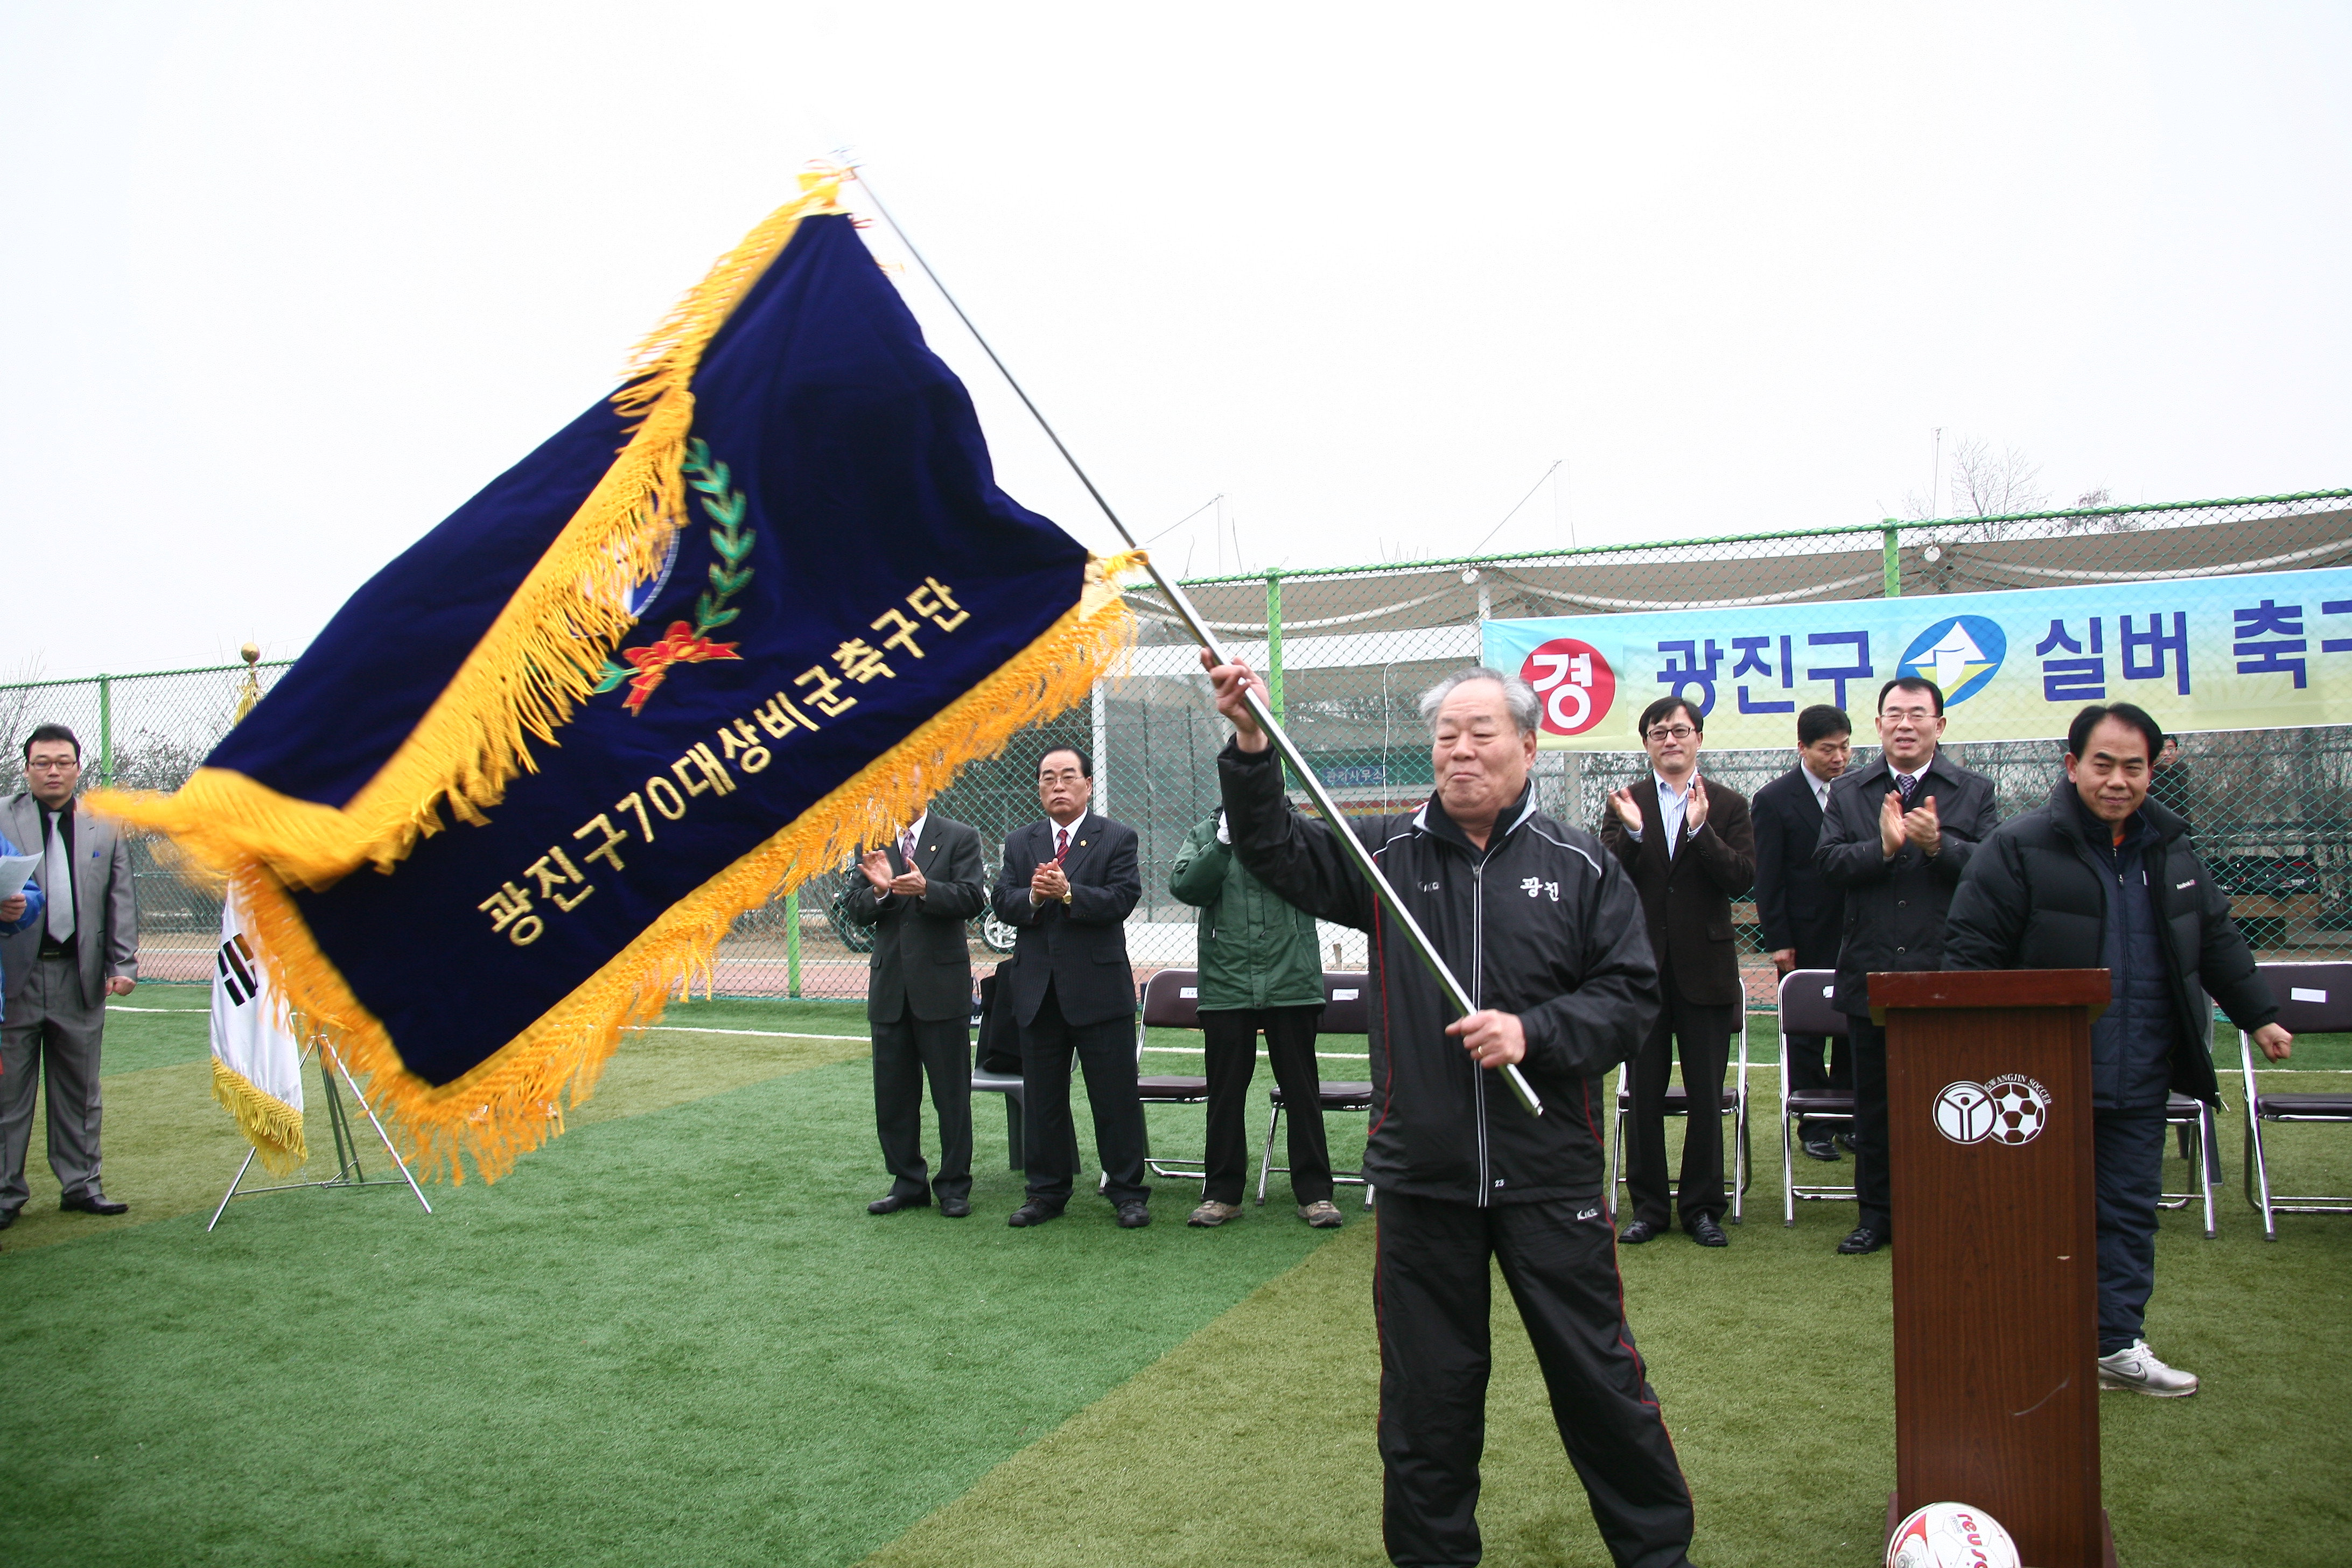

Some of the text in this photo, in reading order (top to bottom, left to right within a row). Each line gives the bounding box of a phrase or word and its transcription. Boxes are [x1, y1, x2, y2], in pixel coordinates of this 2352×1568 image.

[1532, 653, 1592, 729] 경
[1657, 631, 1873, 718] 광진구
[2035, 611, 2190, 702] 실버
[1520, 876, 1559, 902] 광진
[1984, 1073, 2052, 1105] GWANGJIN SOCCER
